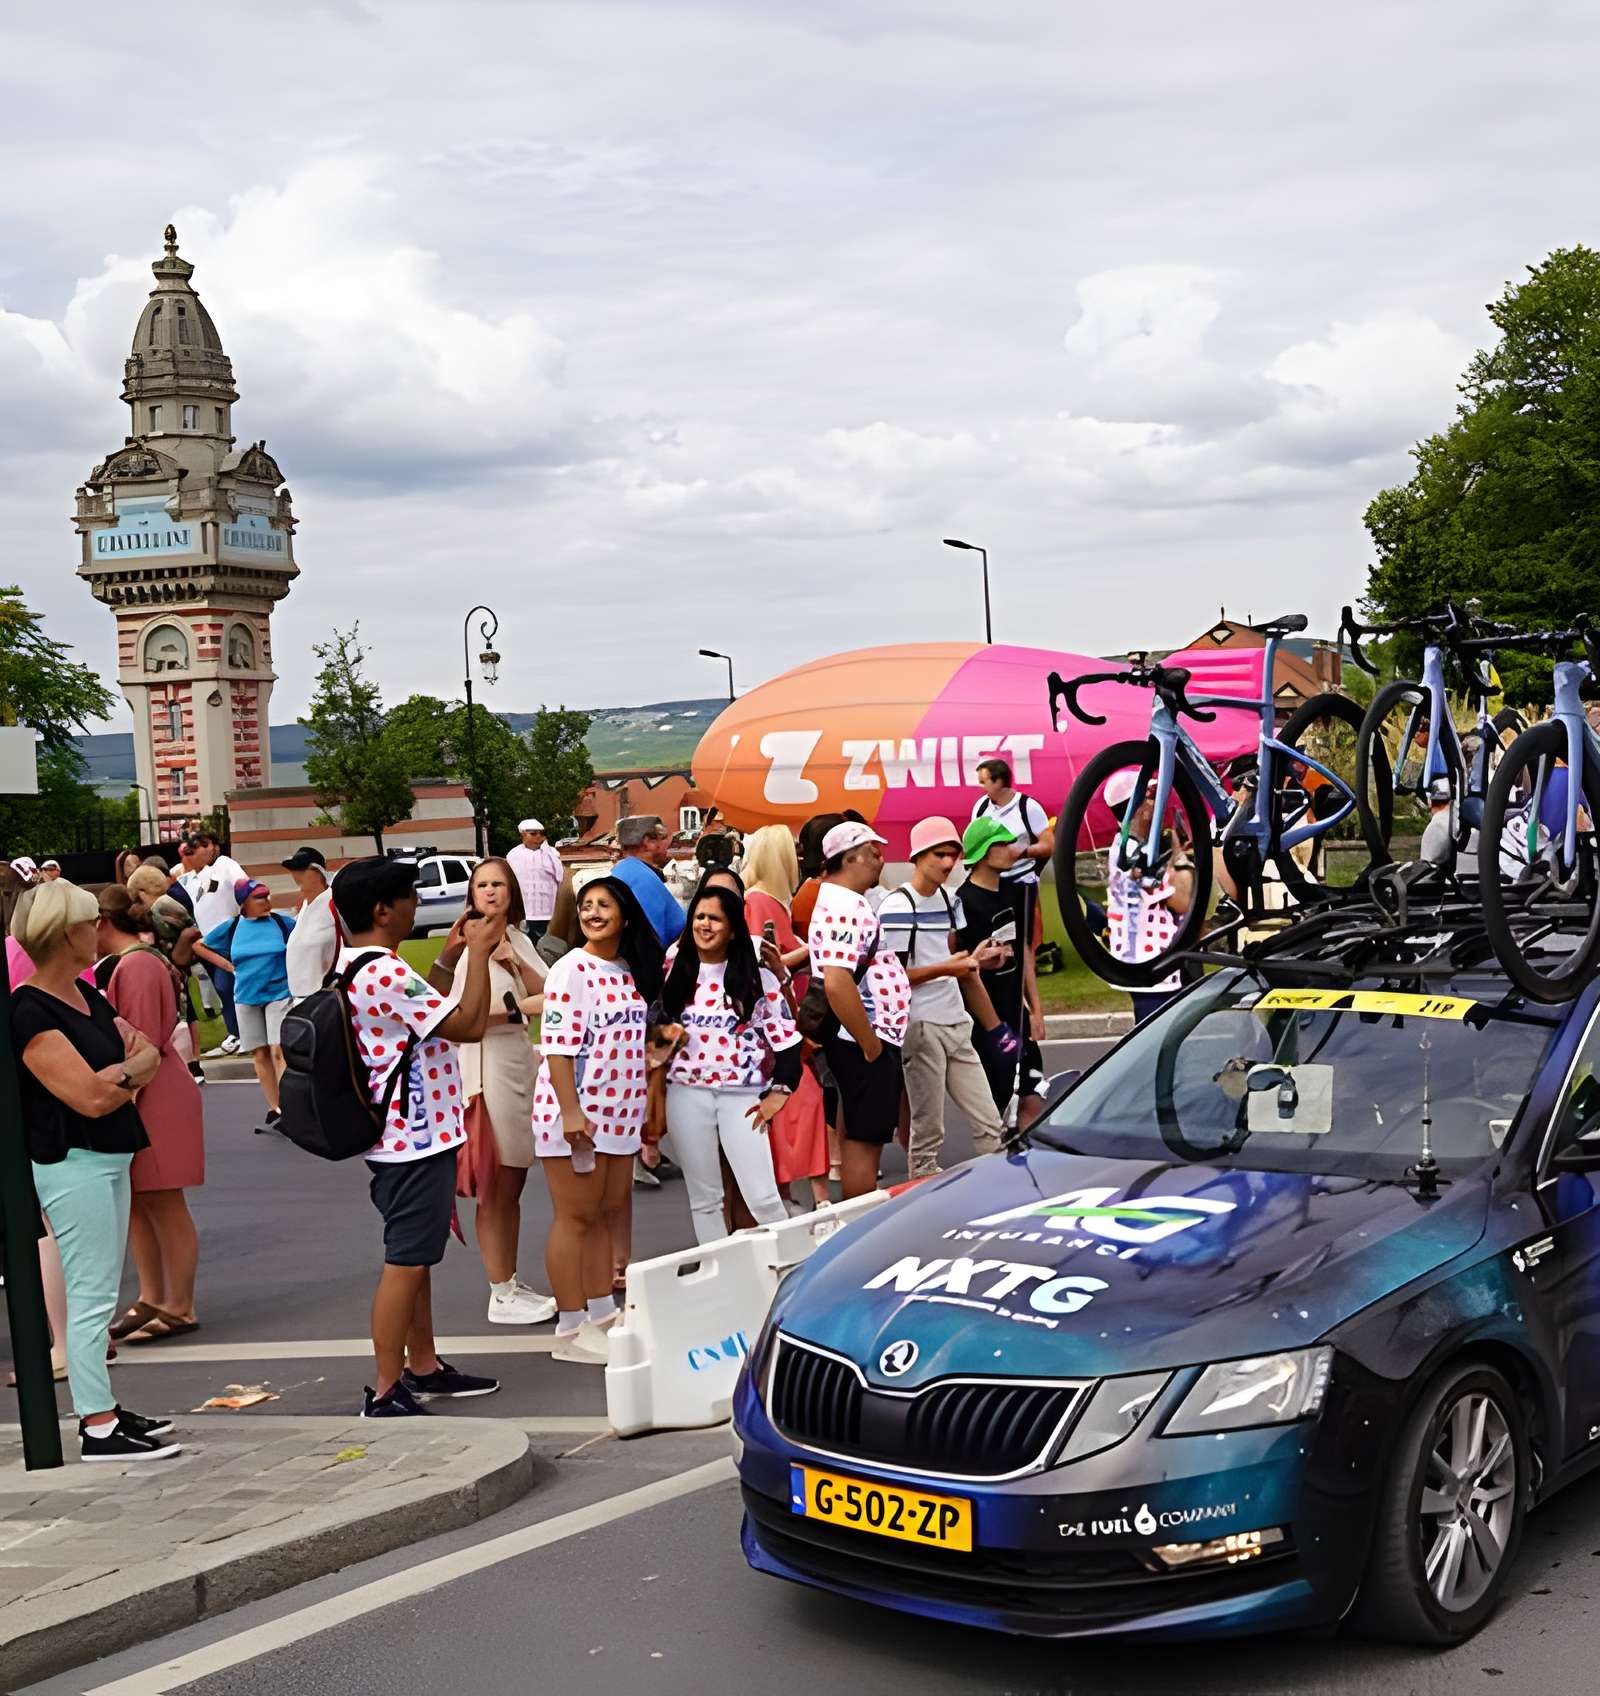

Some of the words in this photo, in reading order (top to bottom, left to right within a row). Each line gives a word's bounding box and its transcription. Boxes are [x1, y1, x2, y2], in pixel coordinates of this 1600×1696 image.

[842, 734, 1044, 790] ZWIFT
[966, 1187, 1237, 1243] AG
[862, 1256, 1110, 1314] NXTG
[815, 1478, 960, 1540] G-502-ZP
